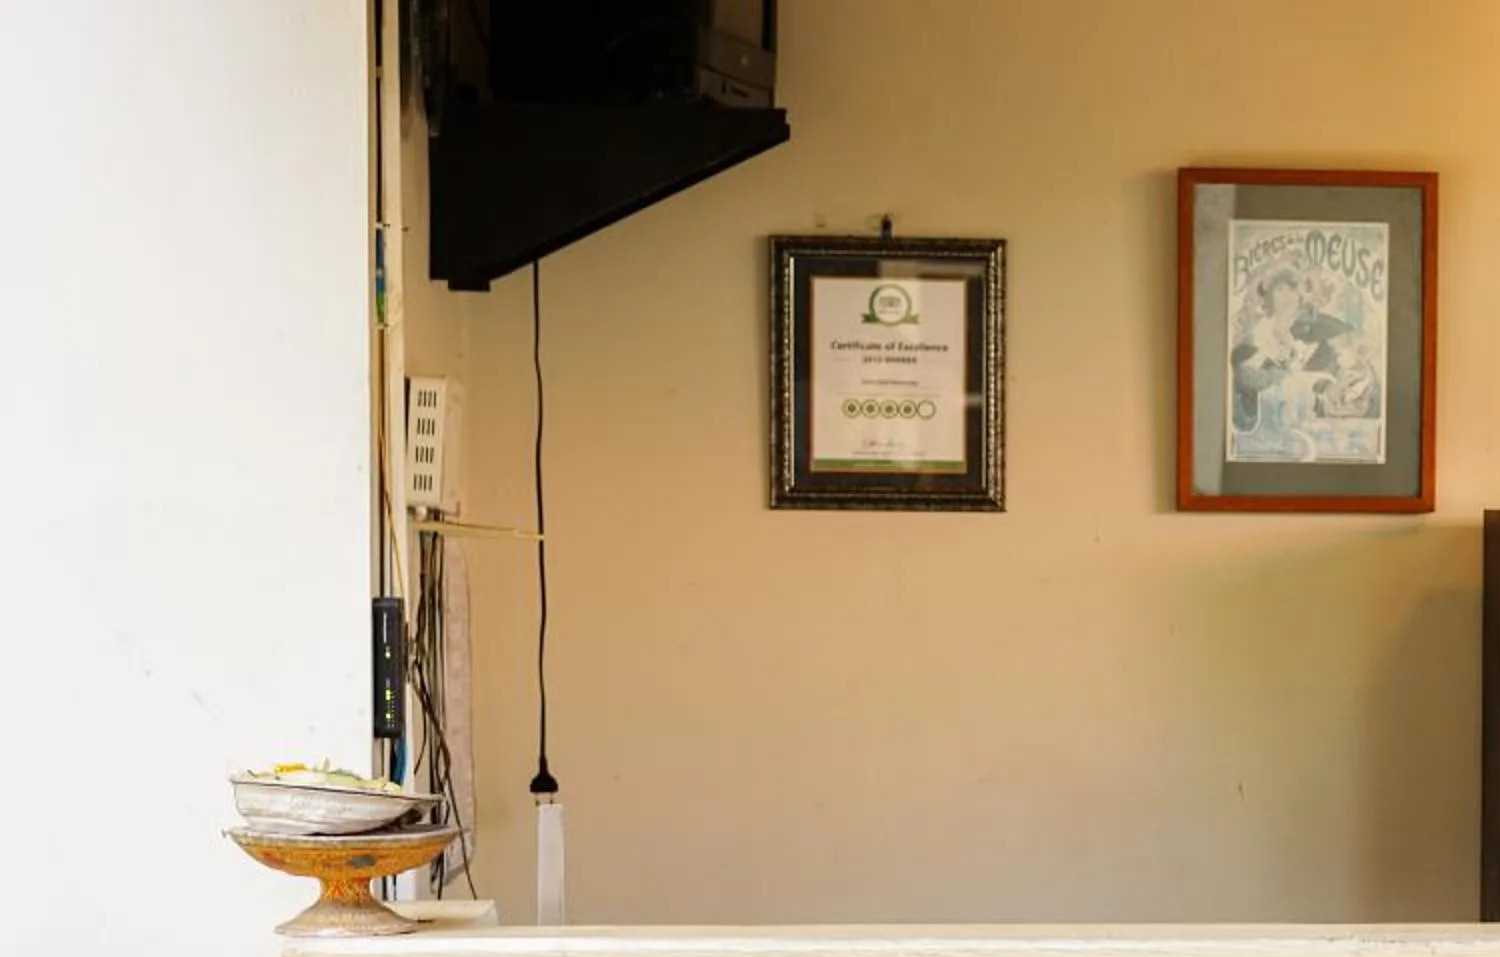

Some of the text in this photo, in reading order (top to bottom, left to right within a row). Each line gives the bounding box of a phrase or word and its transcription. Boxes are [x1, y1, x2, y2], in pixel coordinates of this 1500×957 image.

[1305, 229, 1385, 301] MEUSE
[831, 339, 949, 352] Certificate of Excellence
